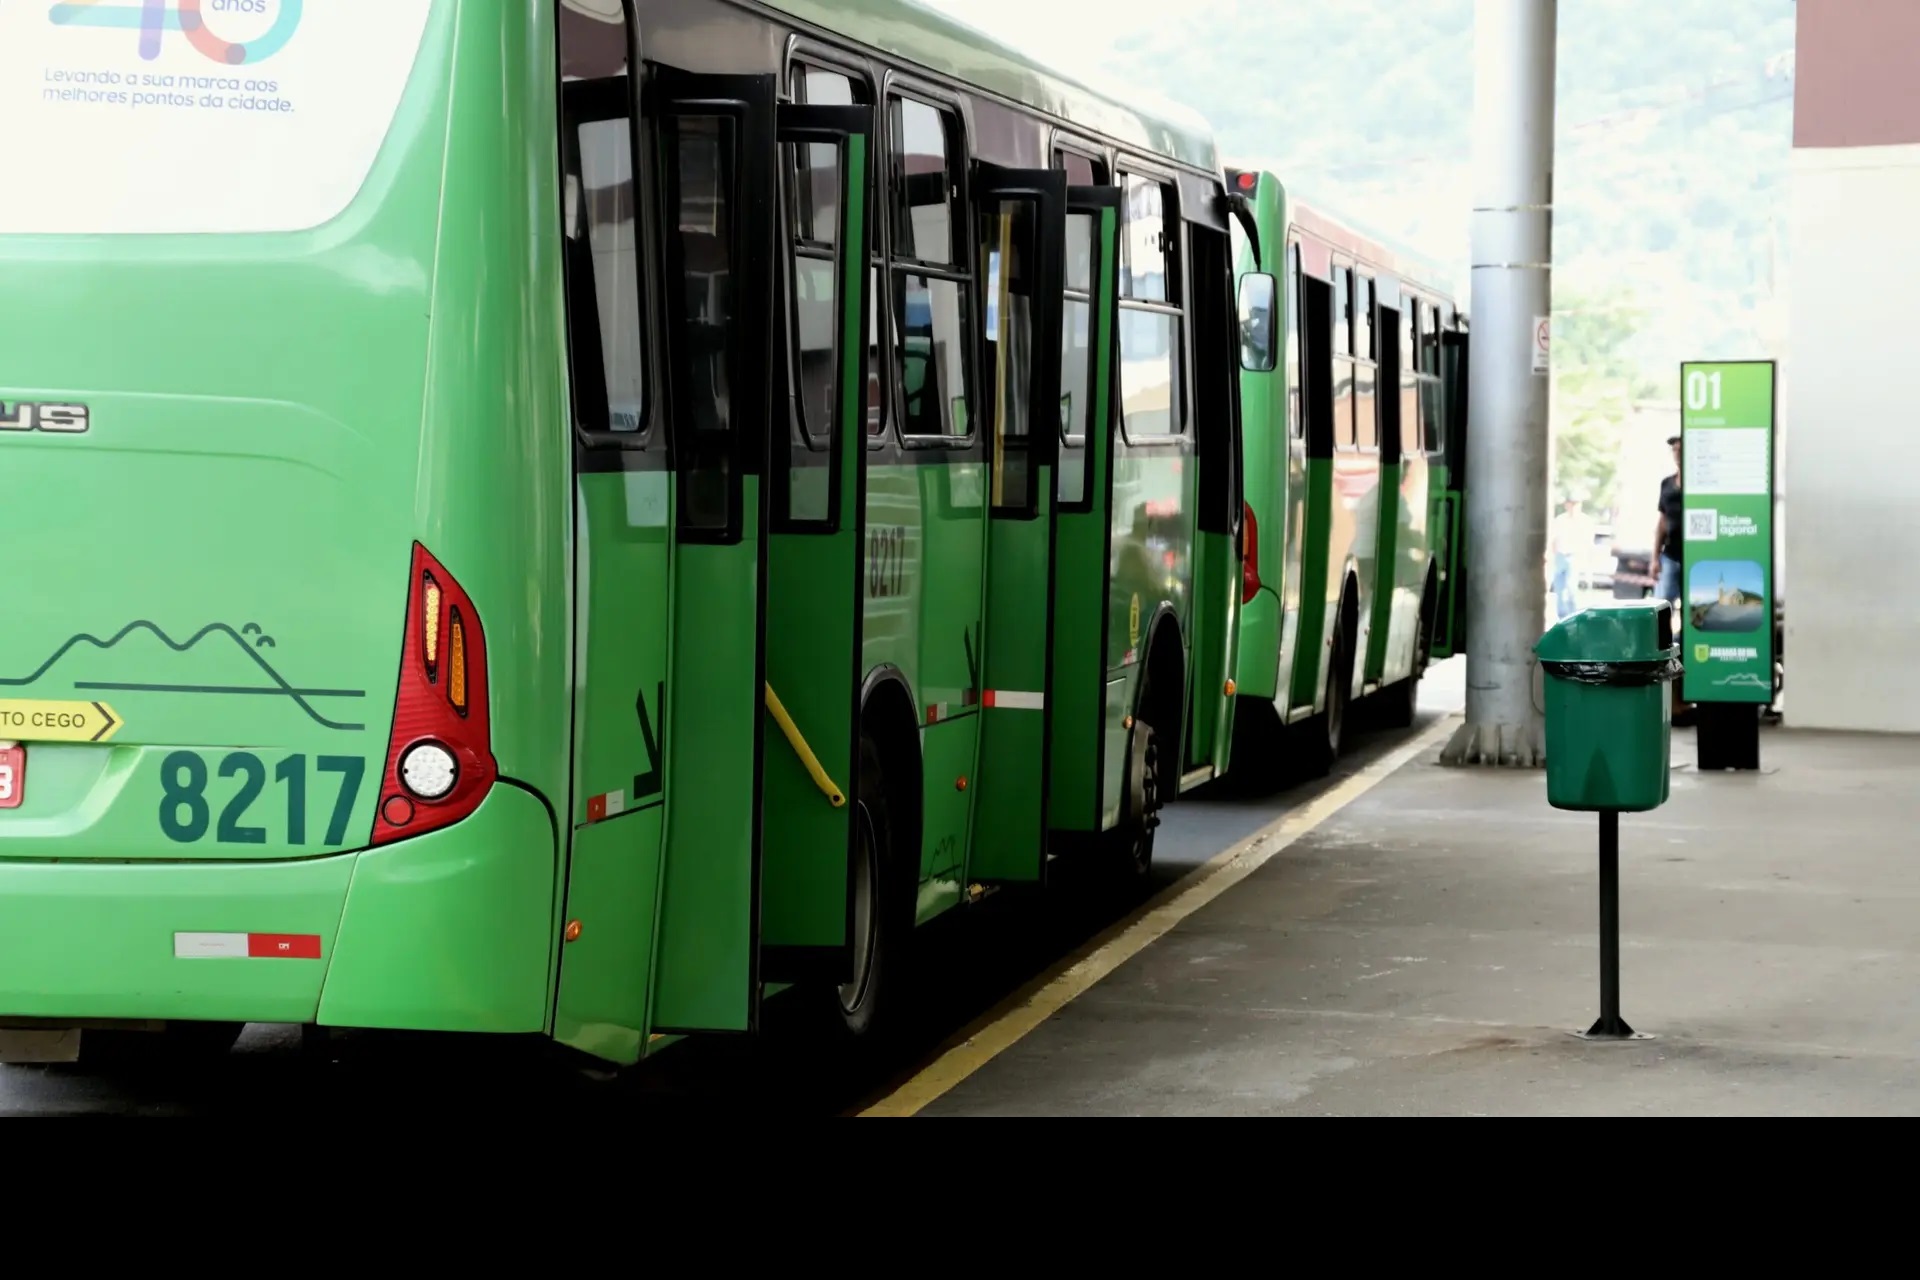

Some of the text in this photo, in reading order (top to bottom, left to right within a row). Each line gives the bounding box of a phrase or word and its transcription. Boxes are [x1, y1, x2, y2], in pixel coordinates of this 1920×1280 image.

[211, 0, 266, 13] anos
[45, 67, 278, 92] Levando a sua marca aos
[43, 87, 295, 112] melhores pontos da cidade.
[1687, 371, 1721, 410] 01
[870, 526, 905, 598] 8217
[0, 712, 86, 728] TO CEGO
[159, 750, 366, 846] 8217
